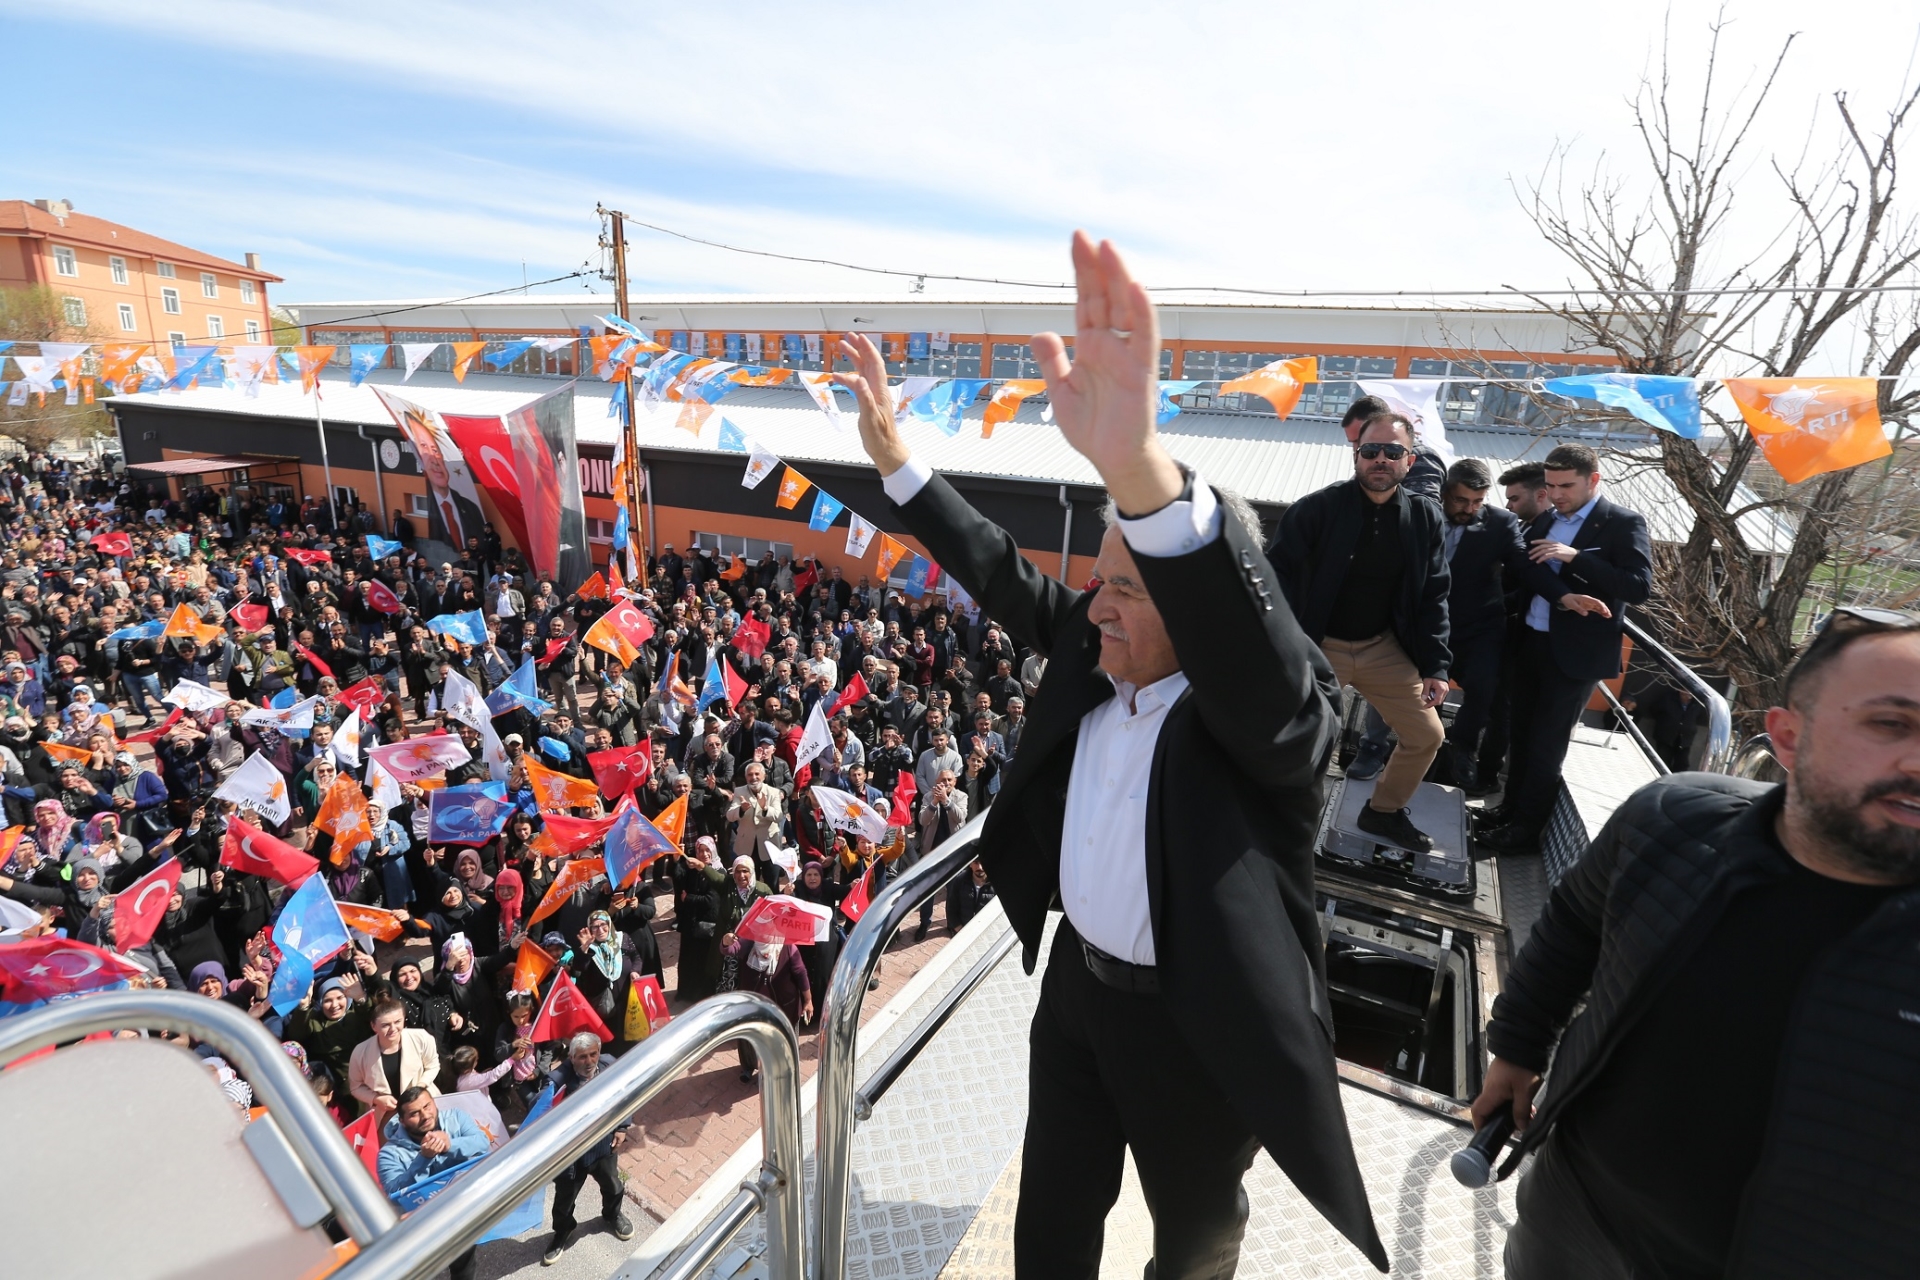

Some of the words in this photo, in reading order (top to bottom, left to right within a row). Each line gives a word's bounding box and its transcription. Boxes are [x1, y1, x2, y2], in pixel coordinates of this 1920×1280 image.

[1757, 433, 1774, 452] A
[577, 457, 618, 495] ONU
[451, 703, 461, 713] AK
[410, 767, 425, 778] AK
[240, 798, 257, 808] AK
[459, 830, 475, 838] AK
[539, 894, 554, 909] AK
